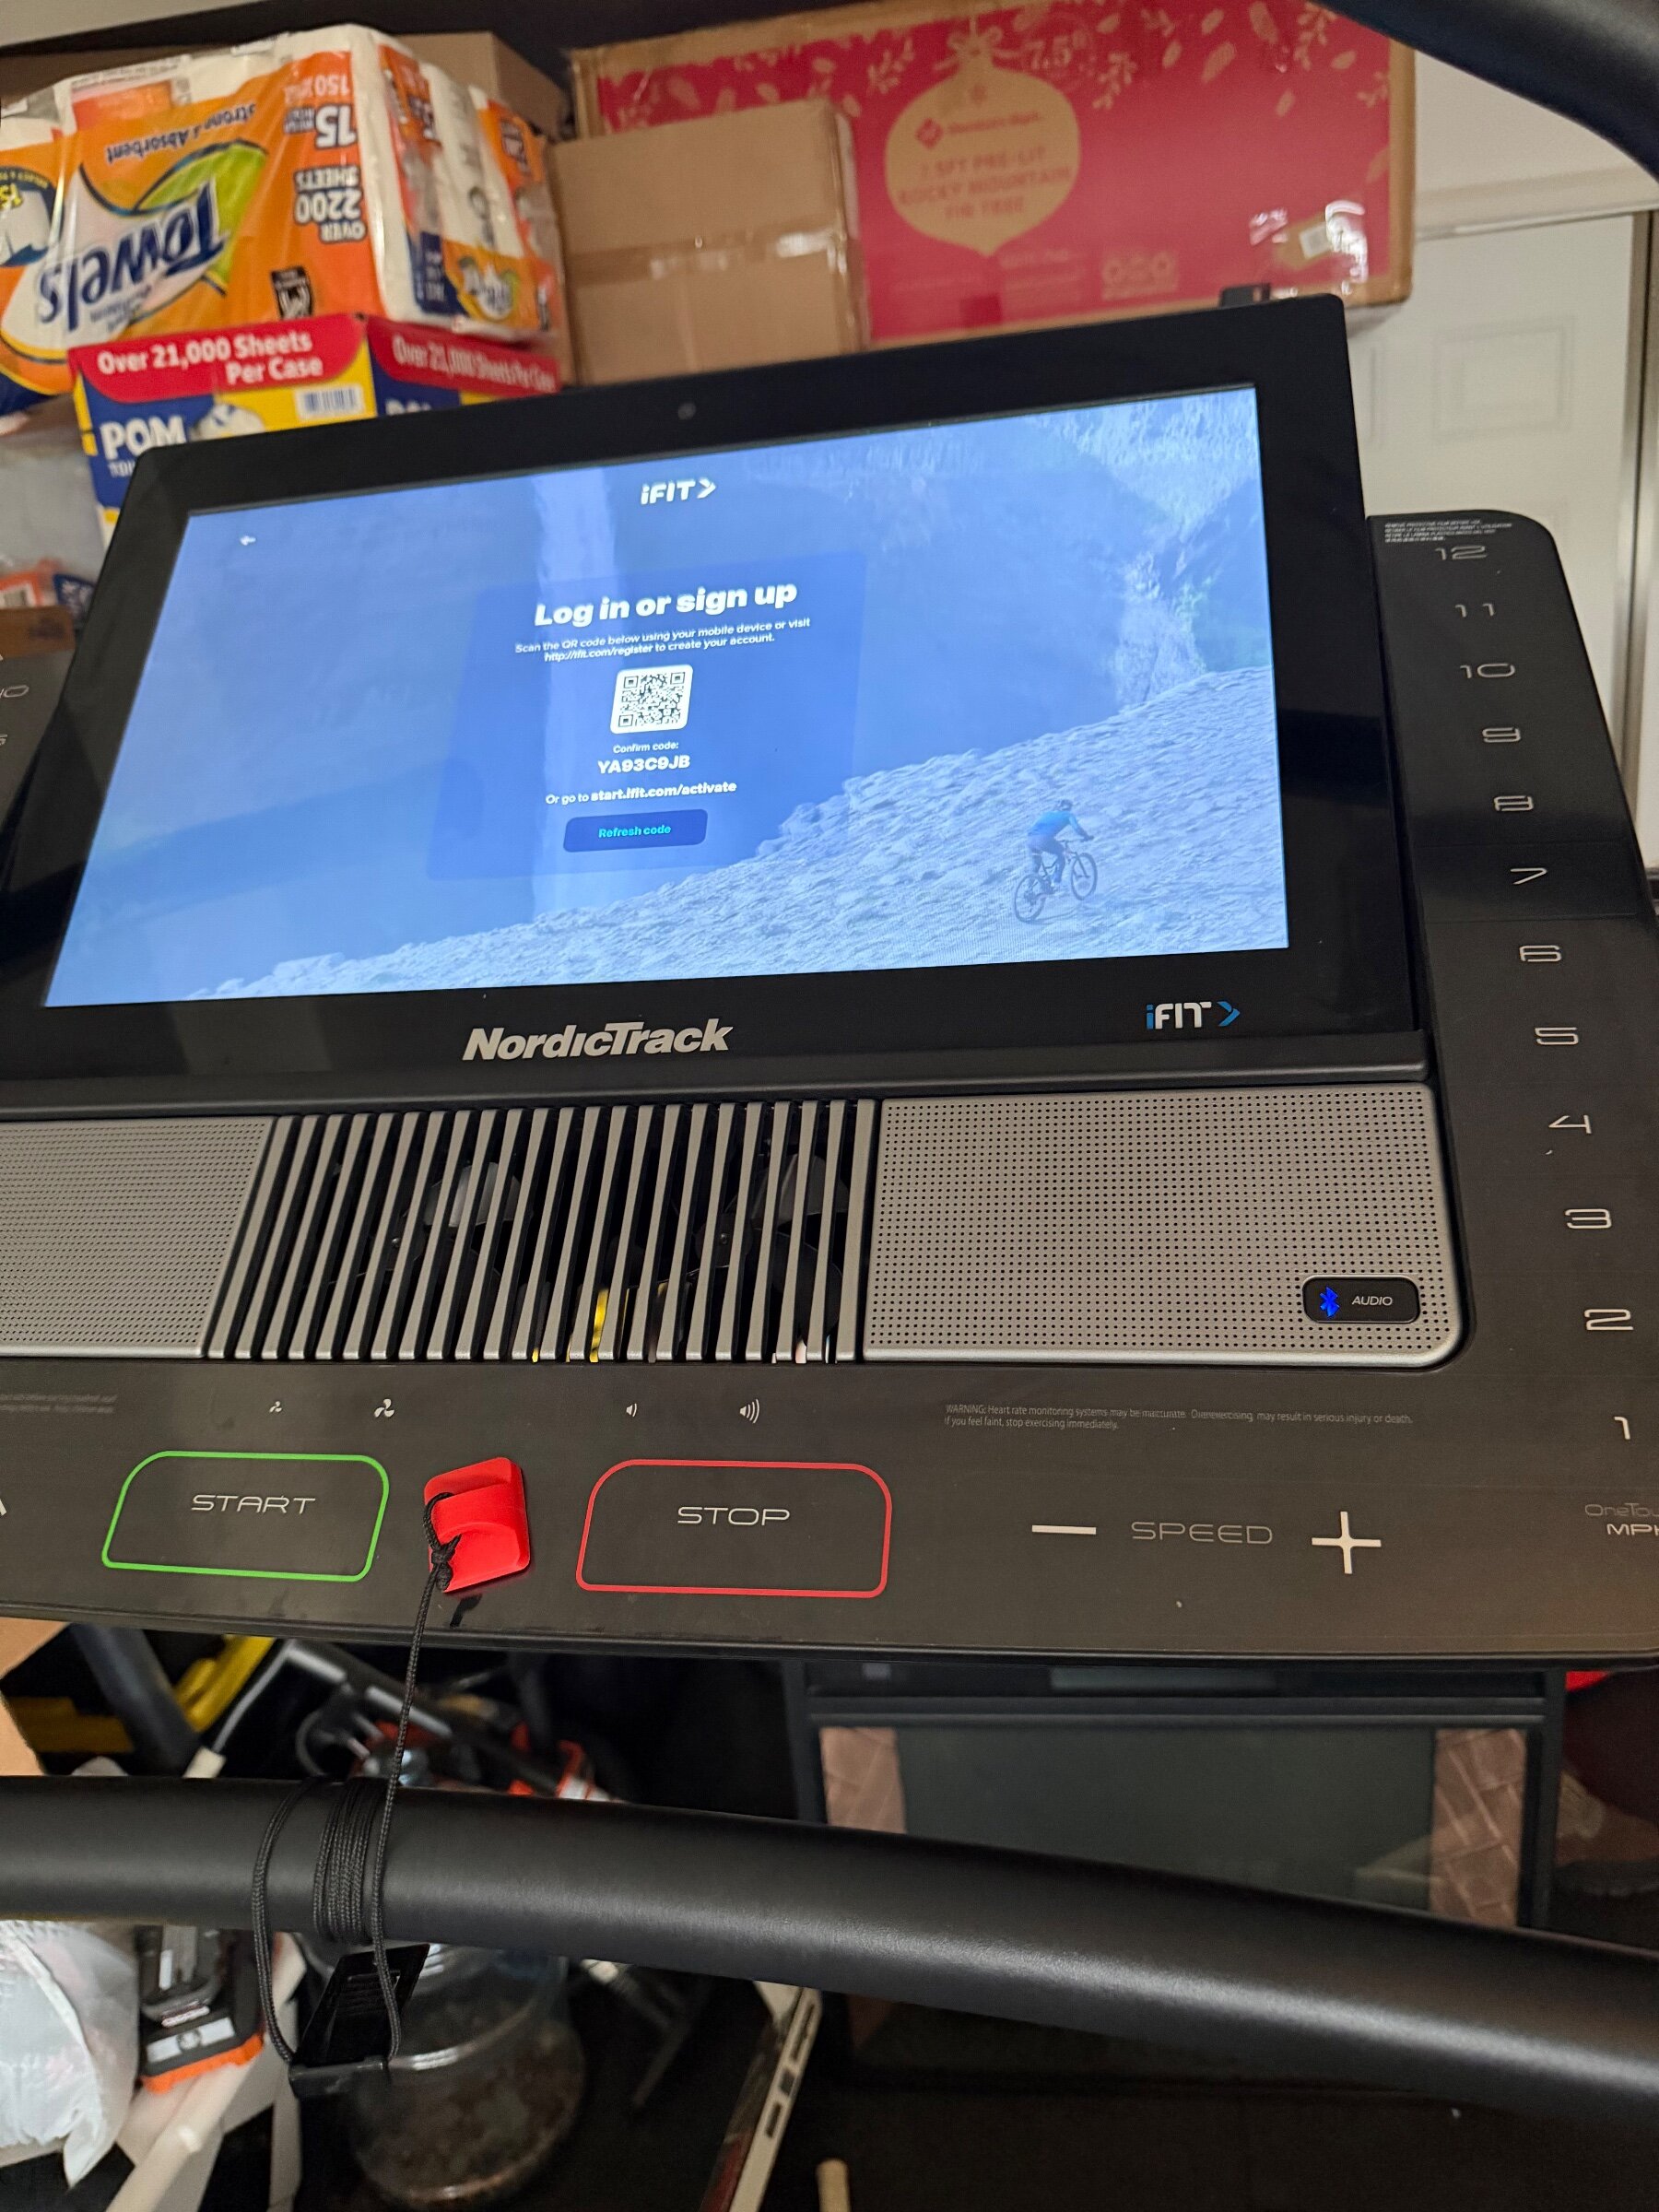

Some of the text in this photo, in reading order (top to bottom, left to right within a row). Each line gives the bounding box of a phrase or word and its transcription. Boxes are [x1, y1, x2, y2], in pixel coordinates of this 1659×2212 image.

[315, 105, 357, 148] 15
[105, 130, 190, 164] Absorbent
[296, 165, 359, 190] SHEETS
[296, 187, 362, 223] 2200
[321, 220, 366, 241] OVER
[39, 178, 227, 333] Towels
[97, 330, 313, 375] Over 21,000 Sheets
[392, 334, 429, 368] Over
[225, 357, 324, 385] Per Case
[100, 415, 187, 461] POM
[641, 478, 696, 505] iFIT
[1435, 546, 1488, 560] 12
[535, 583, 797, 628] Log in or sign up
[1454, 602, 1497, 618] 11
[514, 617, 810, 653] Scan the QR code below using your mobile device or visit
[654, 642, 665, 653] to
[667, 639, 701, 651] create
[703, 637, 727, 650] your
[730, 632, 775, 646] account.
[1459, 663, 1516, 679] 10
[1481, 726, 1522, 743] 9
[613, 741, 679, 754] Confirm code:
[597, 754, 691, 774] YA93C9JB
[545, 782, 737, 806] Or go to start.ifit.com/activate
[1493, 794, 1535, 812] 8
[598, 824, 672, 839] Refresh code
[1509, 866, 1548, 886] 7
[1518, 945, 1563, 963] 6
[1146, 1001, 1211, 1030] iFIT
[461, 1018, 734, 1062] NordicTrack
[1533, 1026, 1580, 1046] 5
[1547, 1113, 1594, 1135] 4
[1563, 1207, 1612, 1230] 3
[1350, 1294, 1394, 1307] AUDIO
[1583, 1307, 1634, 1332] 2
[946, 1404, 986, 1415] WARNING:
[987, 1405, 1010, 1415] Heart
[1011, 1406, 1028, 1415] rate
[1029, 1406, 1075, 1418] monitoring
[1109, 1408, 1127, 1419] may
[1256, 1412, 1276, 1422] may
[1277, 1411, 1301, 1421] result
[1302, 1411, 1312, 1421] in
[1313, 1413, 1345, 1422] serious
[1346, 1413, 1371, 1425] injury
[1372, 1415, 1383, 1423] or
[951, 1418, 966, 1428] you
[968, 1416, 983, 1427] feel
[984, 1416, 1005, 1428] faint,
[1006, 1418, 1024, 1429] stop
[1025, 1418, 1065, 1430] exercising
[1613, 1416, 1631, 1440] 1
[190, 1493, 316, 1516] START
[677, 1505, 791, 1527] STOP
[1130, 1521, 1273, 1545] SPEED
